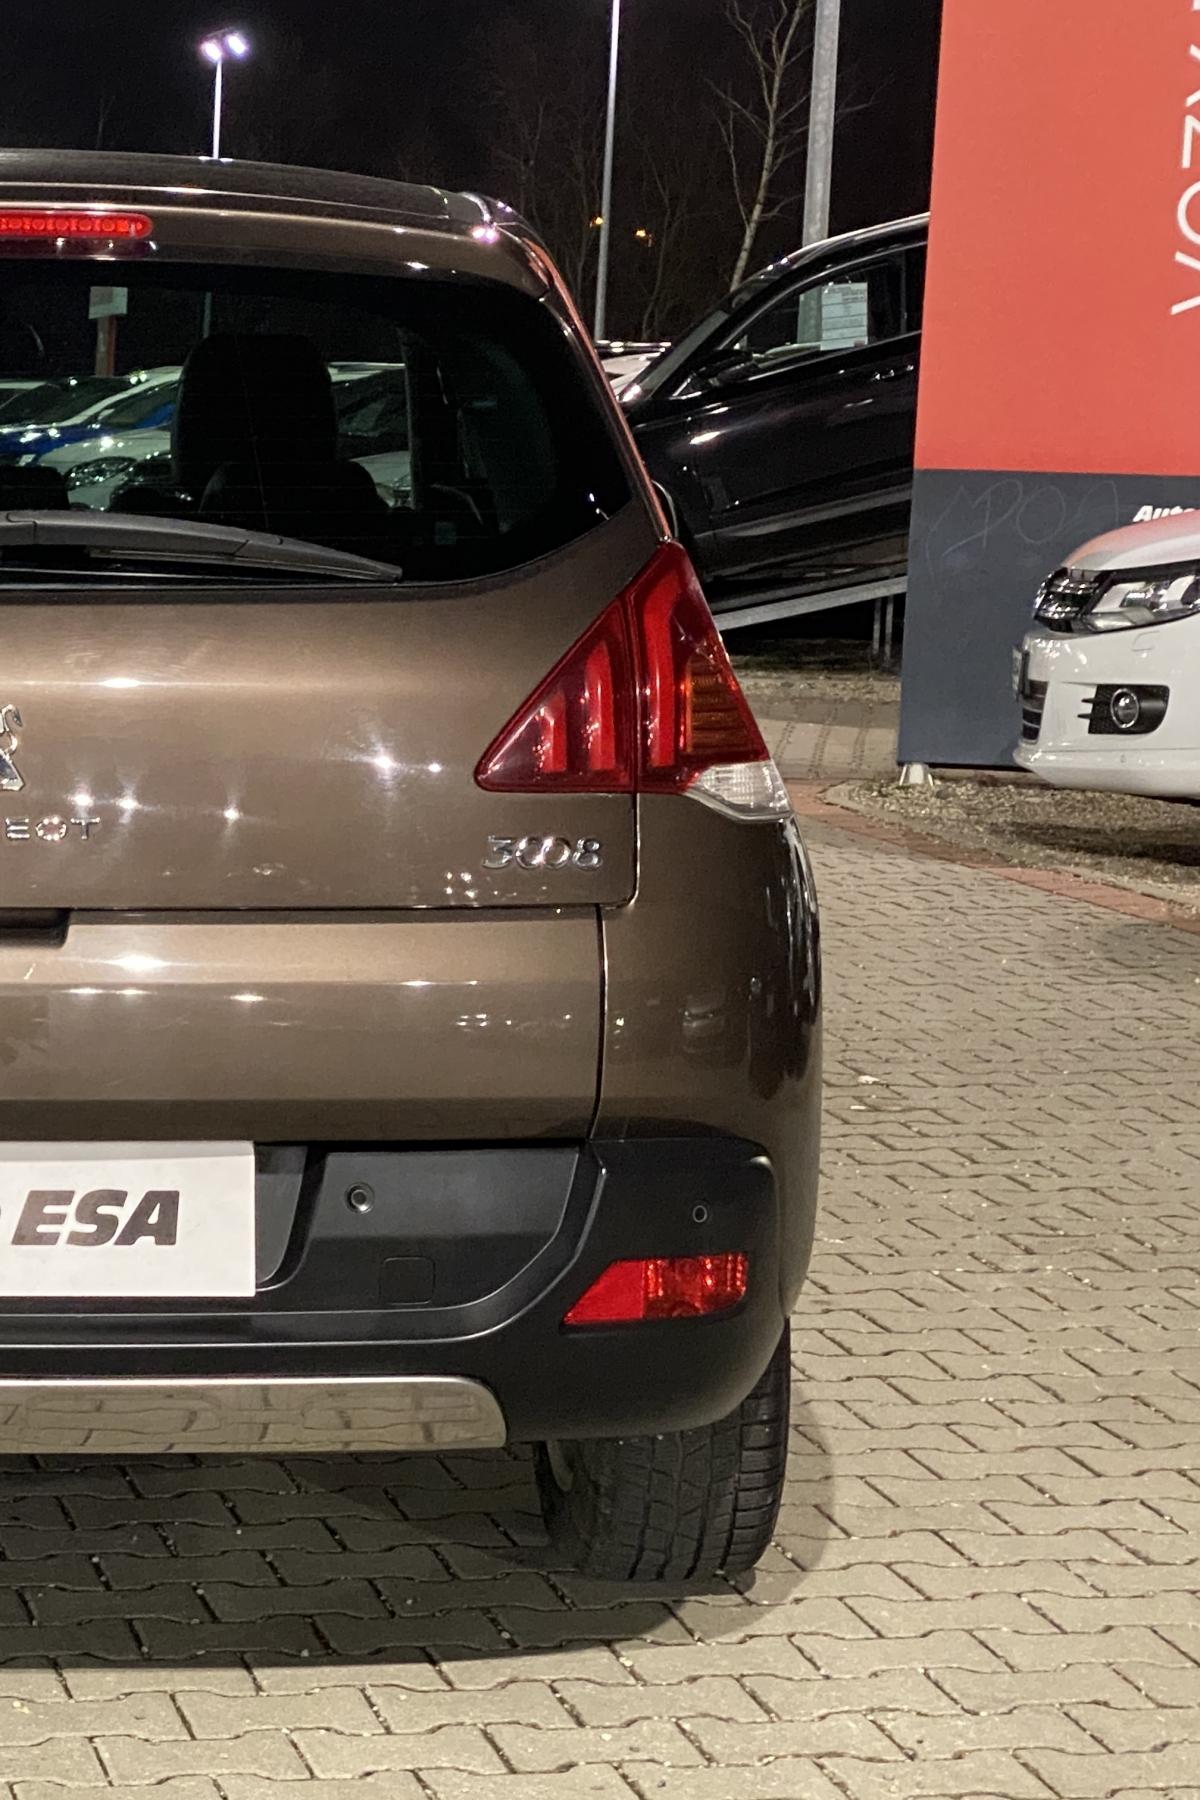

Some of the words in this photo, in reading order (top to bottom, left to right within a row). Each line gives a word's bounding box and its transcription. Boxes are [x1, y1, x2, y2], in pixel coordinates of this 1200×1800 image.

[1132, 504, 1196, 522] Aut
[481, 835, 603, 871] 3008
[10, 1189, 180, 1247] ESA
